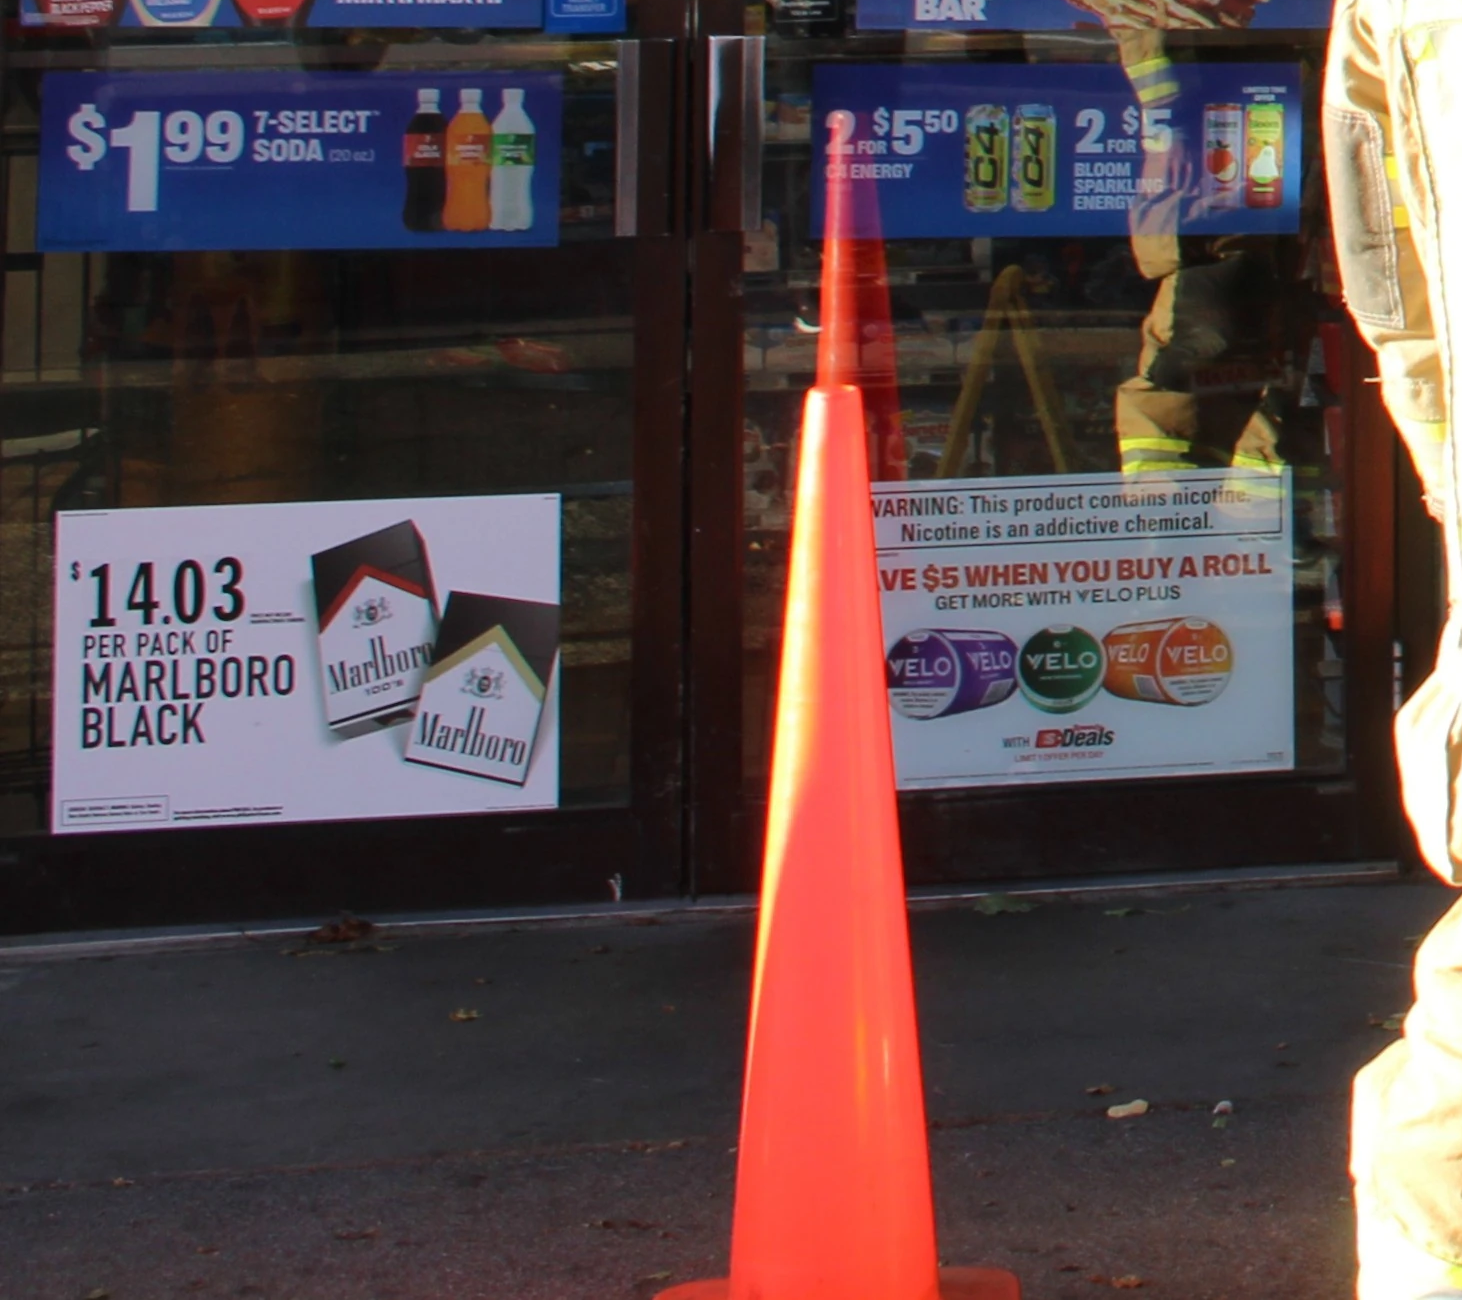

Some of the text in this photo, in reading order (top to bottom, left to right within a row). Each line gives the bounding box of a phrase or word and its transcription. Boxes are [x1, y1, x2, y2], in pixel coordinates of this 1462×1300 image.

[252, 109, 371, 134] 7-SELECT
[825, 110, 889, 155] 2 FOR
[1073, 108, 1173, 155] 2 FOR $5
[252, 138, 348, 164] SODA (20
[971, 120, 999, 190] C4
[1021, 124, 1047, 190] C4
[849, 163, 914, 180] ENERGY
[1073, 162, 1131, 180] BLOOM
[1073, 178, 1165, 195] SPARKLING
[1073, 194, 1137, 212] ENERGY
[969, 487, 1252, 517] This product contains nicotine.
[901, 511, 1215, 543] Nicotine is an addictive chemical.
[922, 552, 1274, 592] $5 WHEN YOU BUY A ROLL
[70, 555, 247, 629] $14.03
[934, 585, 1182, 611] GET MORE WITH VELO PLUS
[82, 628, 234, 659] PER PACK OF
[1106, 641, 1152, 665] VELO
[1165, 643, 1231, 665] VELO
[328, 635, 434, 699] Marlboro
[888, 656, 953, 679] VELO
[965, 648, 1014, 673] VELO
[1025, 651, 1098, 673] VELO
[81, 654, 296, 705] MARLBORO
[81, 702, 207, 750] BLACK
[412, 705, 528, 767] Marlboro
[1060, 727, 1116, 748] Deals
